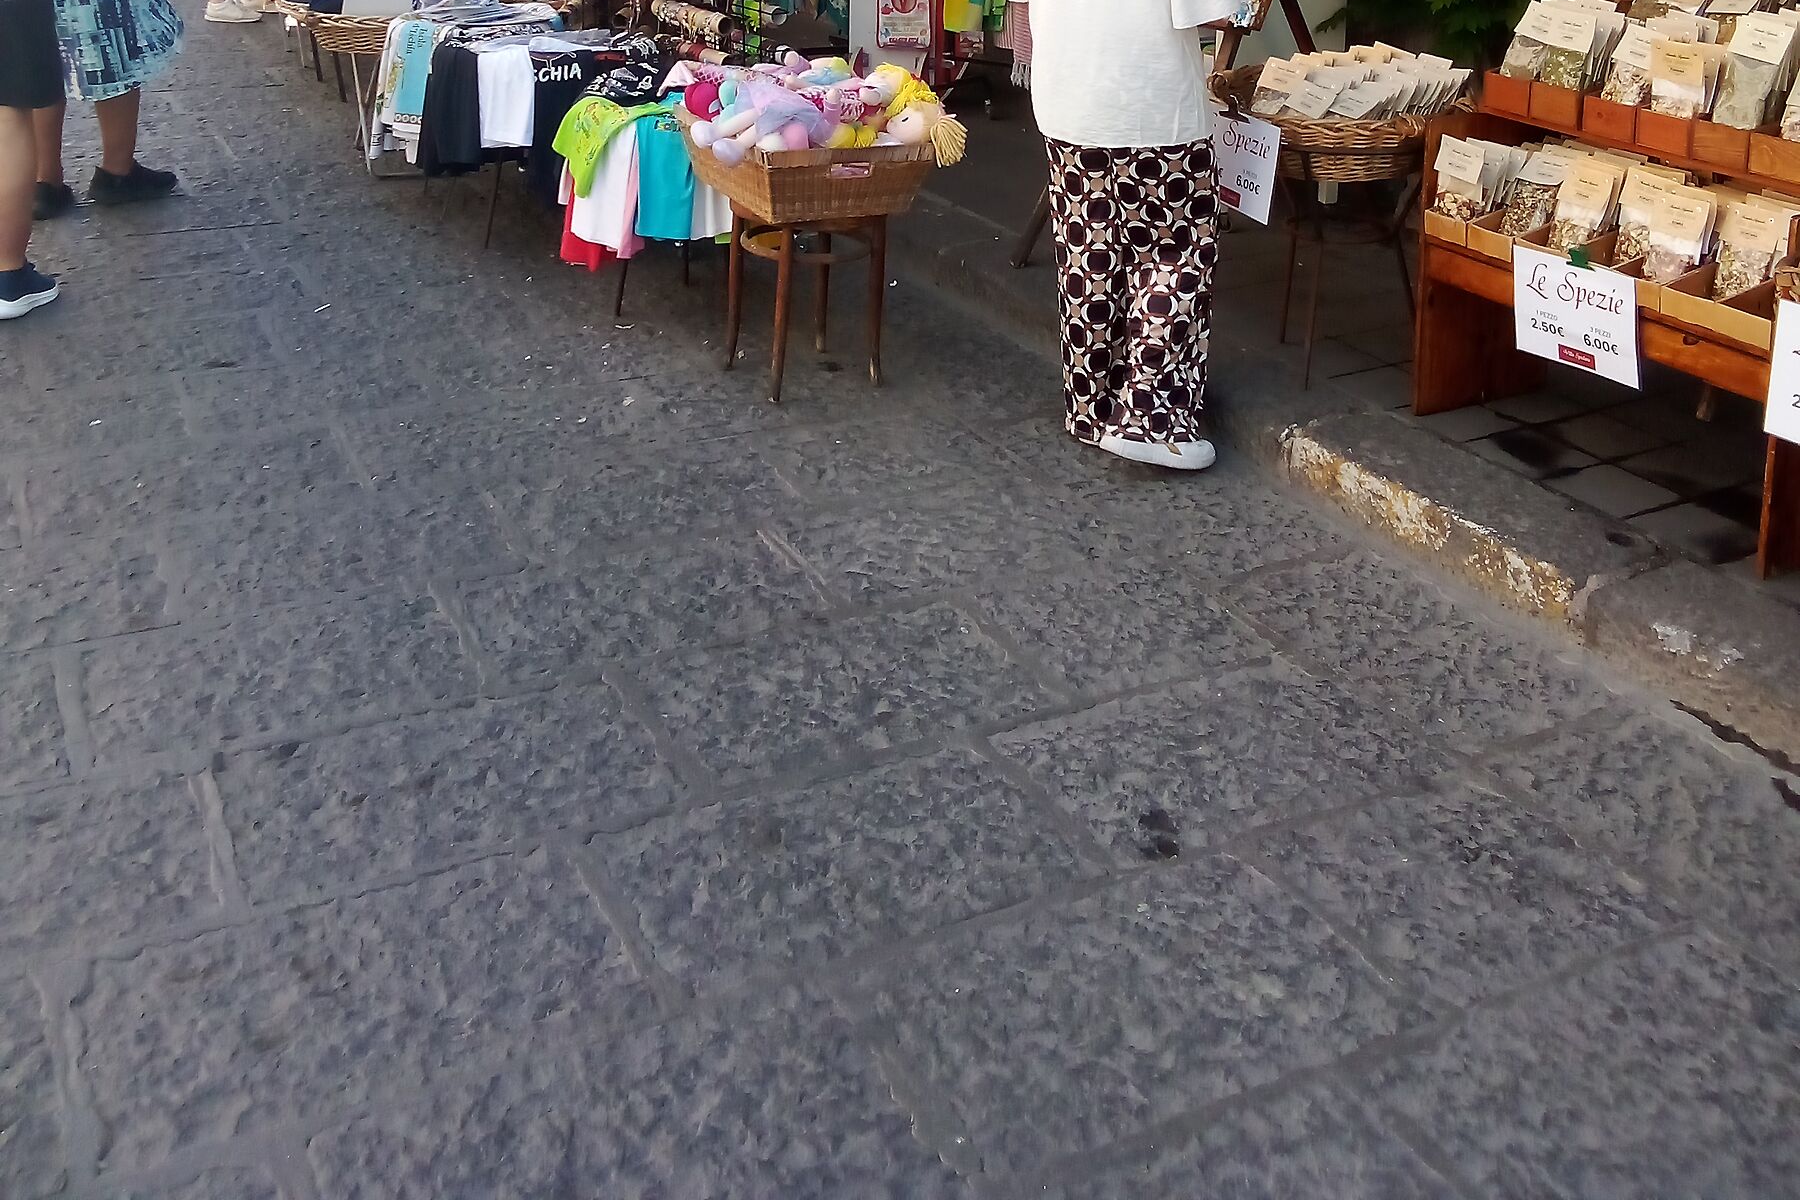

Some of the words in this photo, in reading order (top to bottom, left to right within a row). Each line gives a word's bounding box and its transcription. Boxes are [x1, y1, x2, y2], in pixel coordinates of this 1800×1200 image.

[1222, 120, 1271, 159] Spezie
[1236, 174, 1261, 195] 6.00€
[1526, 263, 1549, 300] Le
[1556, 271, 1624, 315] Spezie
[1530, 318, 1565, 338] 2.50€
[1583, 333, 1619, 356] 6.00€
